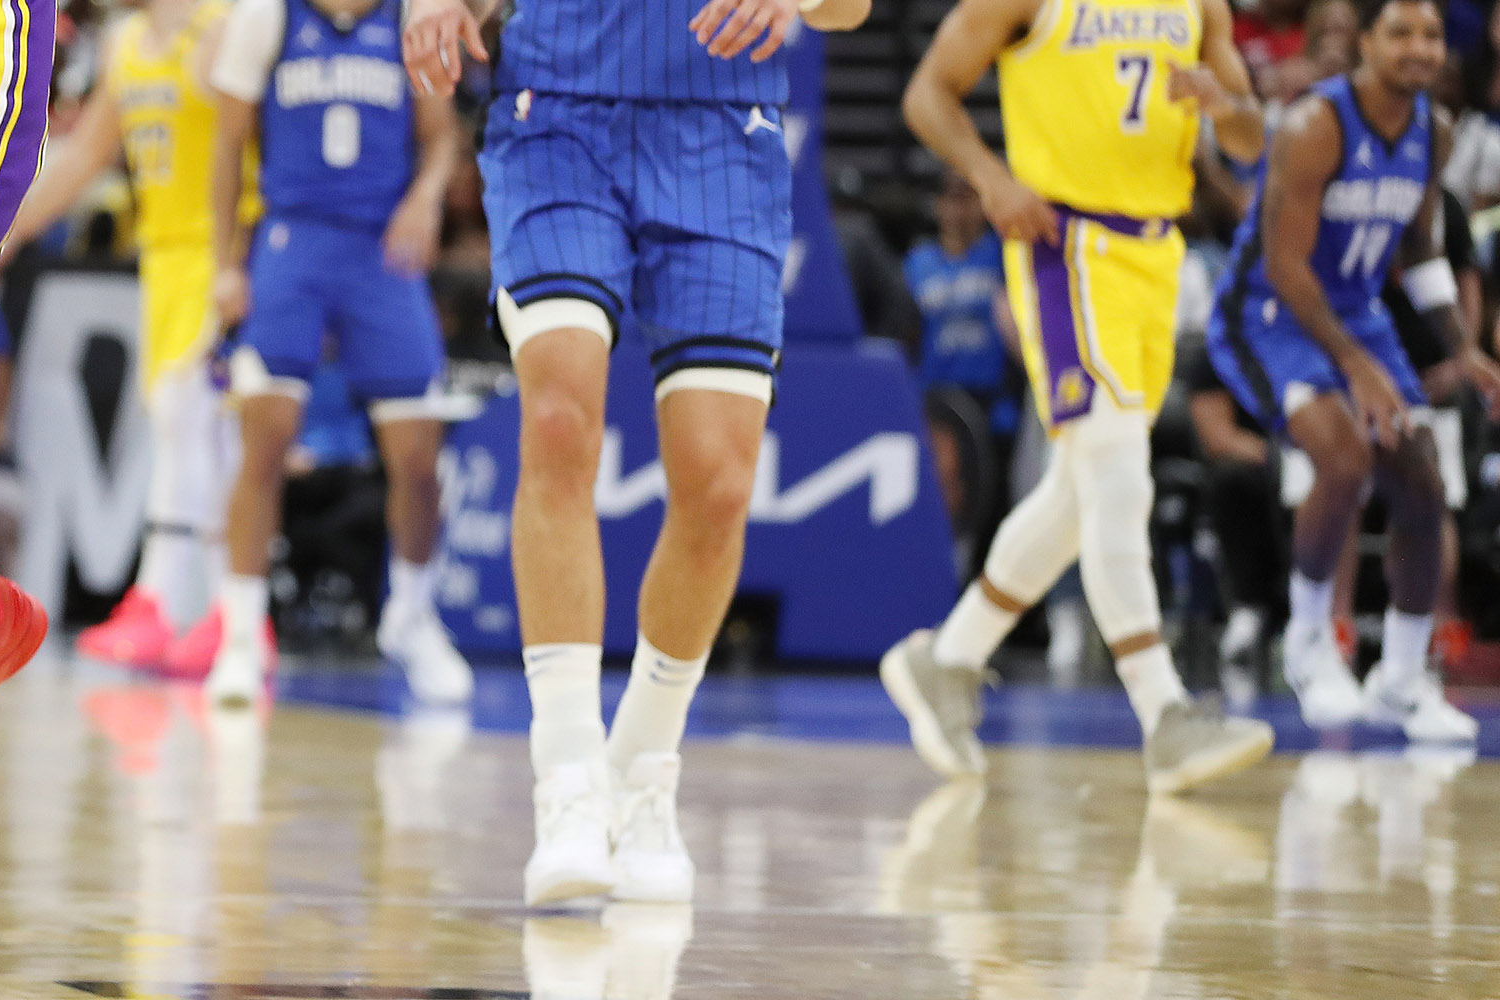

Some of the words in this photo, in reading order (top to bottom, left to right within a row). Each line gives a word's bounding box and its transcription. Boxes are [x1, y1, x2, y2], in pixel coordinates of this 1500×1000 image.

[1062, 1, 1191, 51] LAKERS
[1117, 53, 1154, 134] 7
[322, 102, 360, 169] 0
